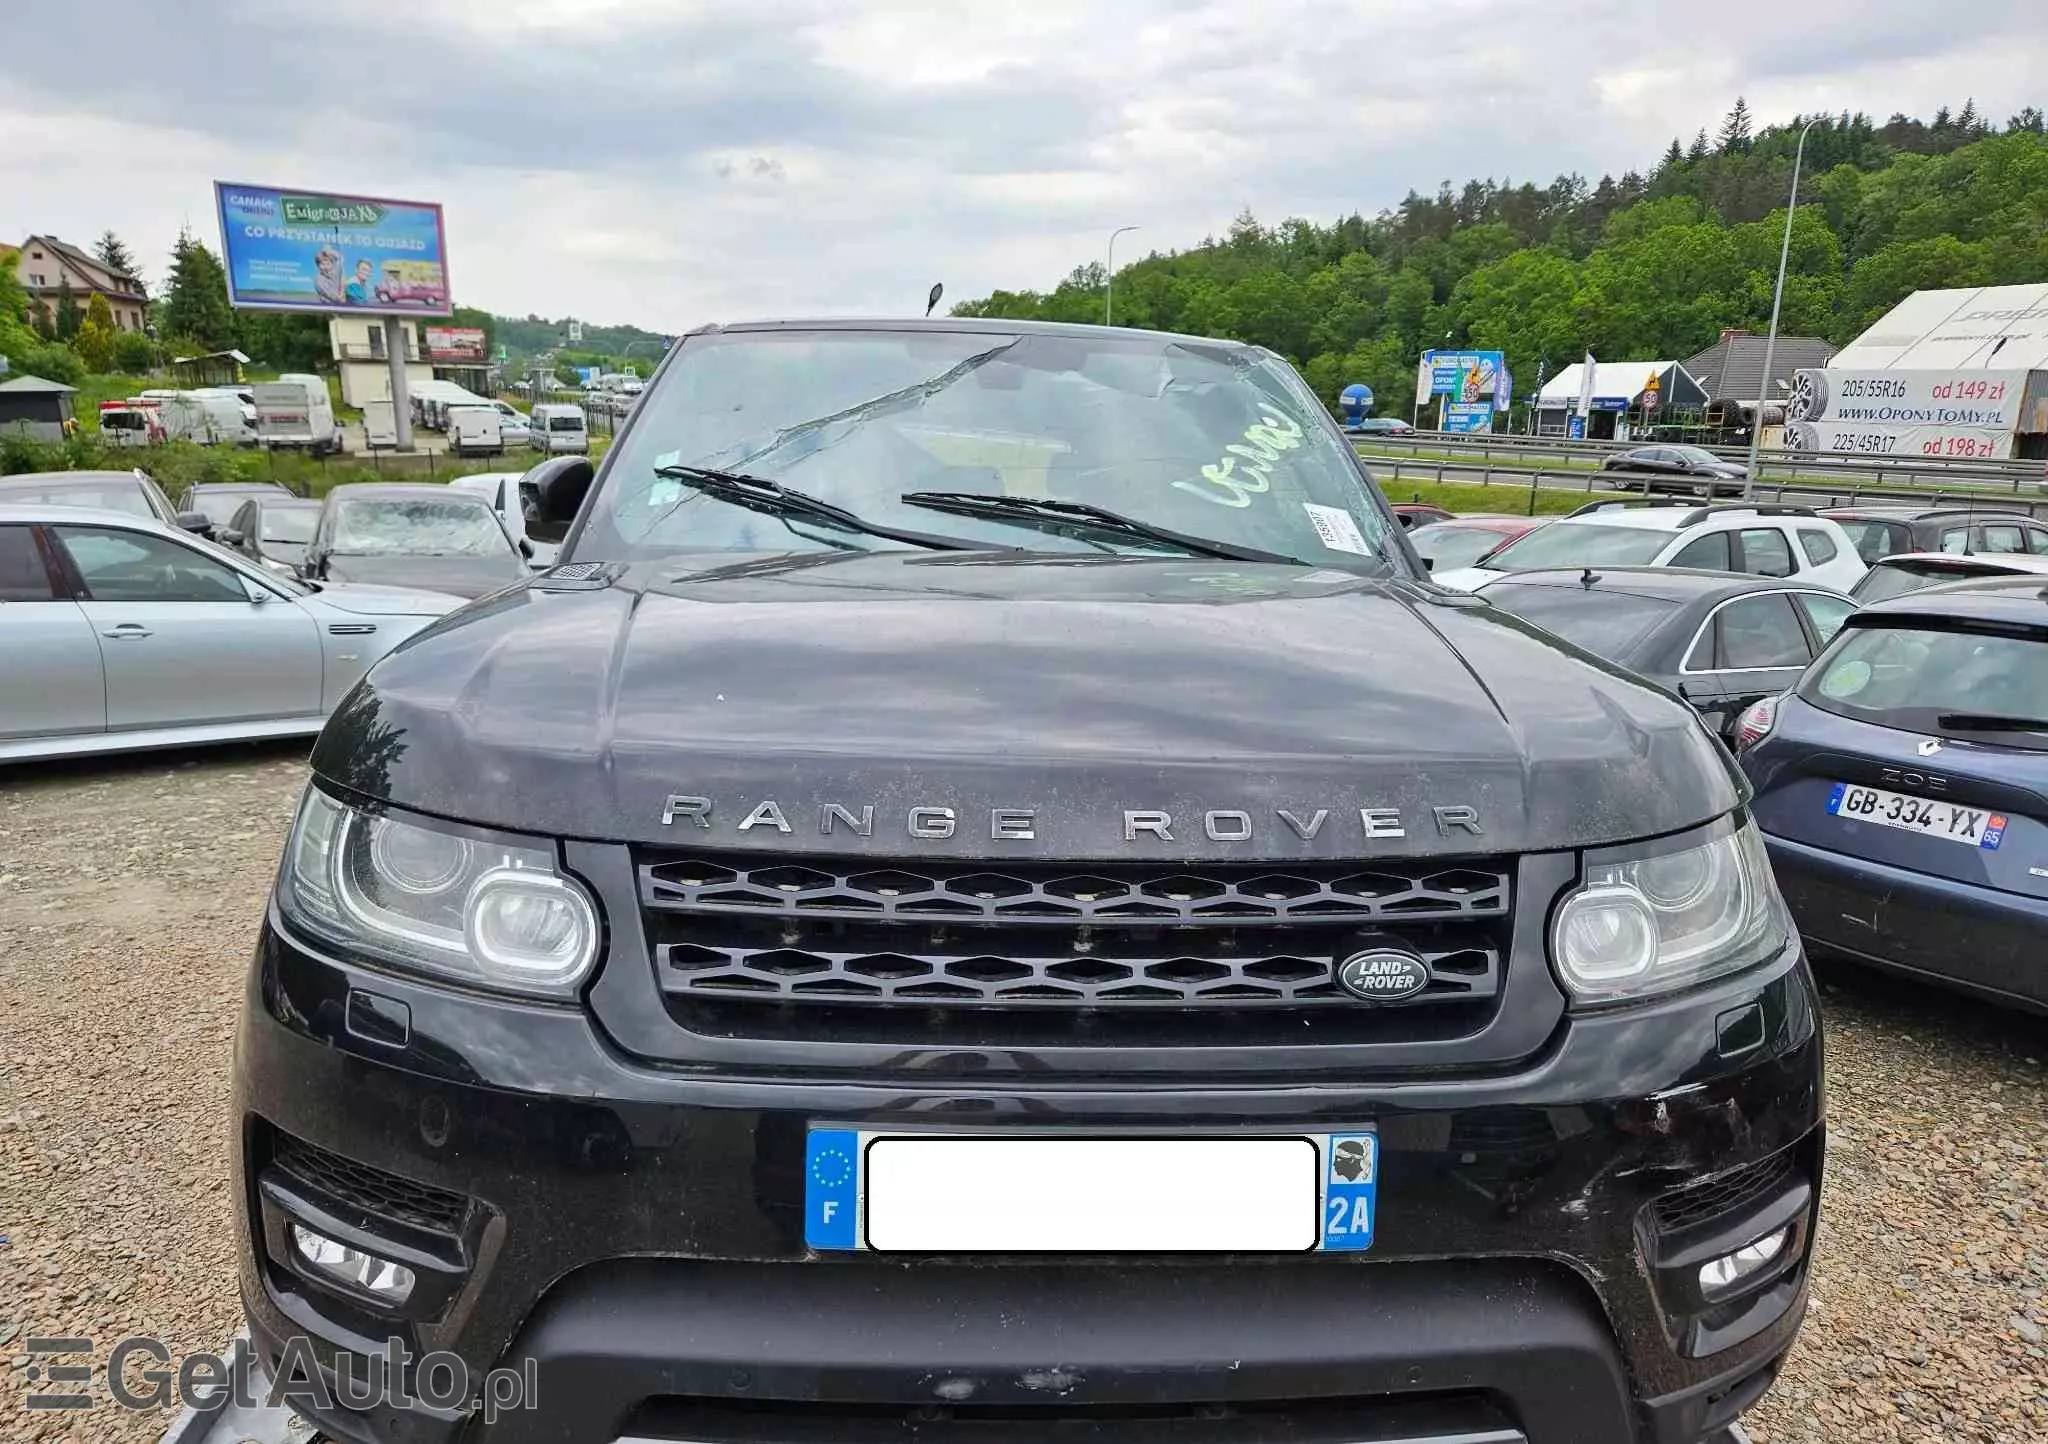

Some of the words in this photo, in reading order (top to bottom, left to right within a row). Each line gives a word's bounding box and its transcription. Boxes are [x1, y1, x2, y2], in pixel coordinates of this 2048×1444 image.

[244, 226, 265, 239] CO
[268, 228, 352, 246] PRZYSTANEK
[357, 235, 372, 248] TO
[375, 237, 426, 251] ODJAZD
[1841, 379, 1906, 398] 205/55R16
[1932, 380, 1953, 399] od
[1955, 380, 1986, 400] 149
[1988, 380, 2006, 400] zł
[1832, 433, 1896, 453] 225/45R17
[1923, 439, 1942, 455] od
[1947, 438, 1976, 457] 198
[1978, 440, 1996, 458] zł
[1881, 768, 1947, 791] ZOE
[662, 795, 1034, 840] RANGE
[1125, 806, 1483, 841] ROVER
[1846, 788, 1982, 838] GB-334-YX
[1983, 830, 2000, 844] 65
[1359, 961, 1402, 975] LAND
[1363, 975, 1415, 989] ROVER
[823, 1201, 839, 1224] F
[1327, 1196, 1369, 1235] 2A
